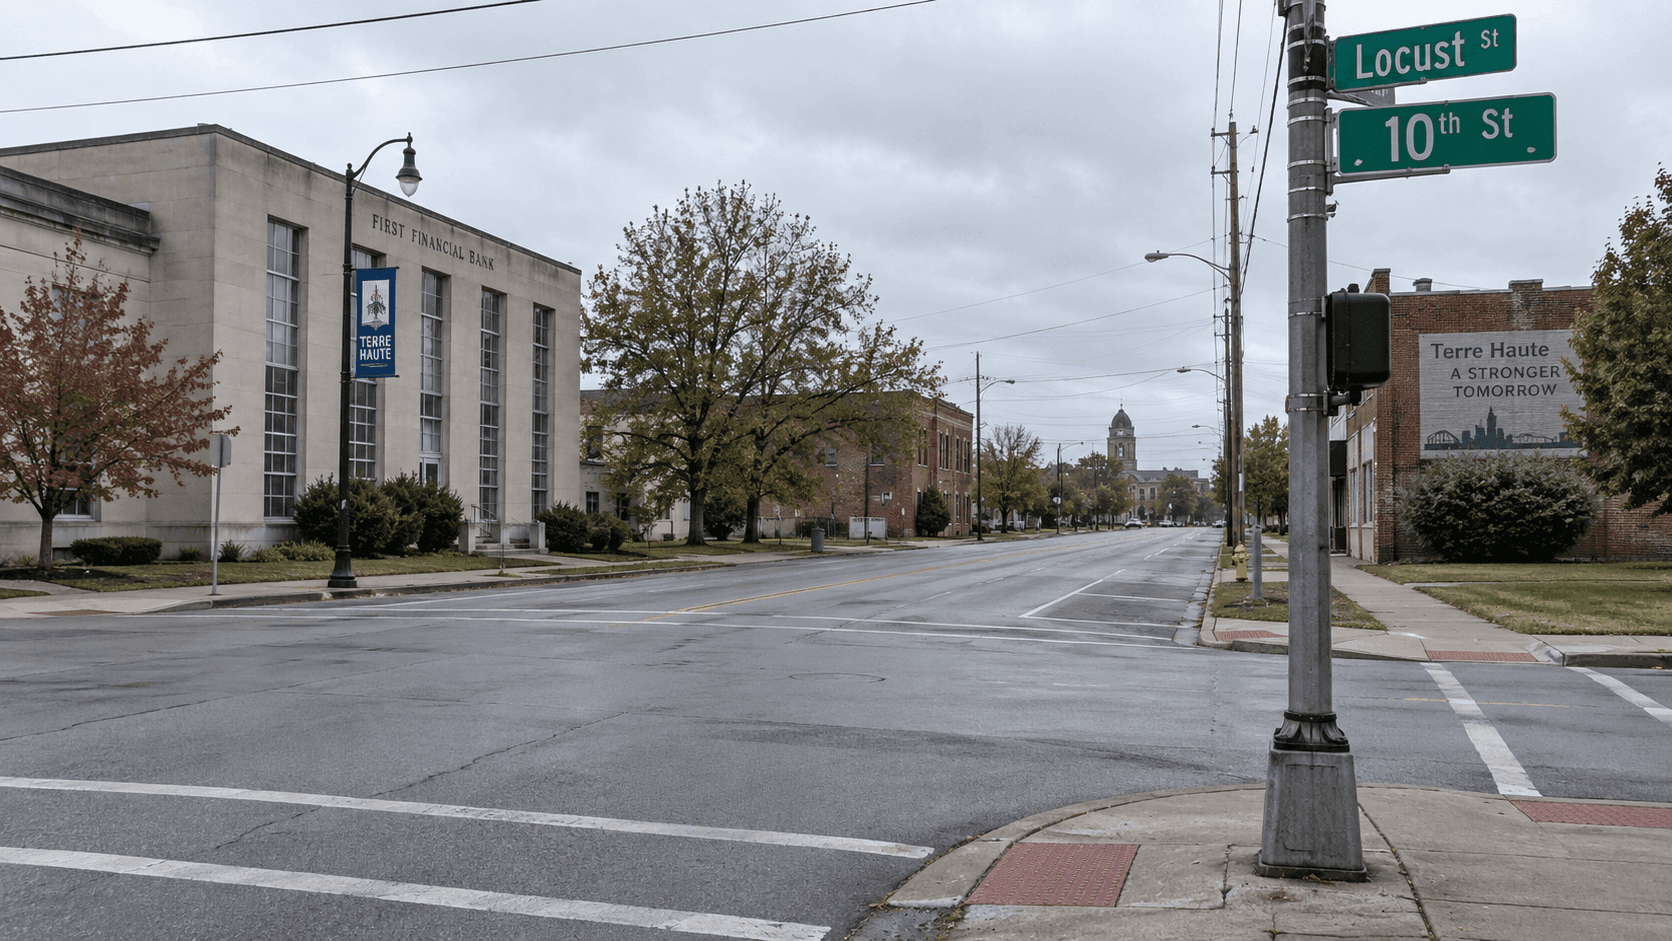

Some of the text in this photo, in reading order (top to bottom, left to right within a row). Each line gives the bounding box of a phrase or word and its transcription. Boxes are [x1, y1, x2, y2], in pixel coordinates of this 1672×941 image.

[1356, 28, 1499, 79] Locust St
[1385, 107, 1513, 162] 10th St
[372, 213, 494, 271] FIRST FINANCIAL BANK
[359, 335, 391, 348] TERRE
[359, 348, 391, 360] HAUTE
[1430, 342, 1549, 359] Terre Haute
[1450, 365, 1561, 380] A STRONGER
[1453, 384, 1557, 398] TOMORROW
